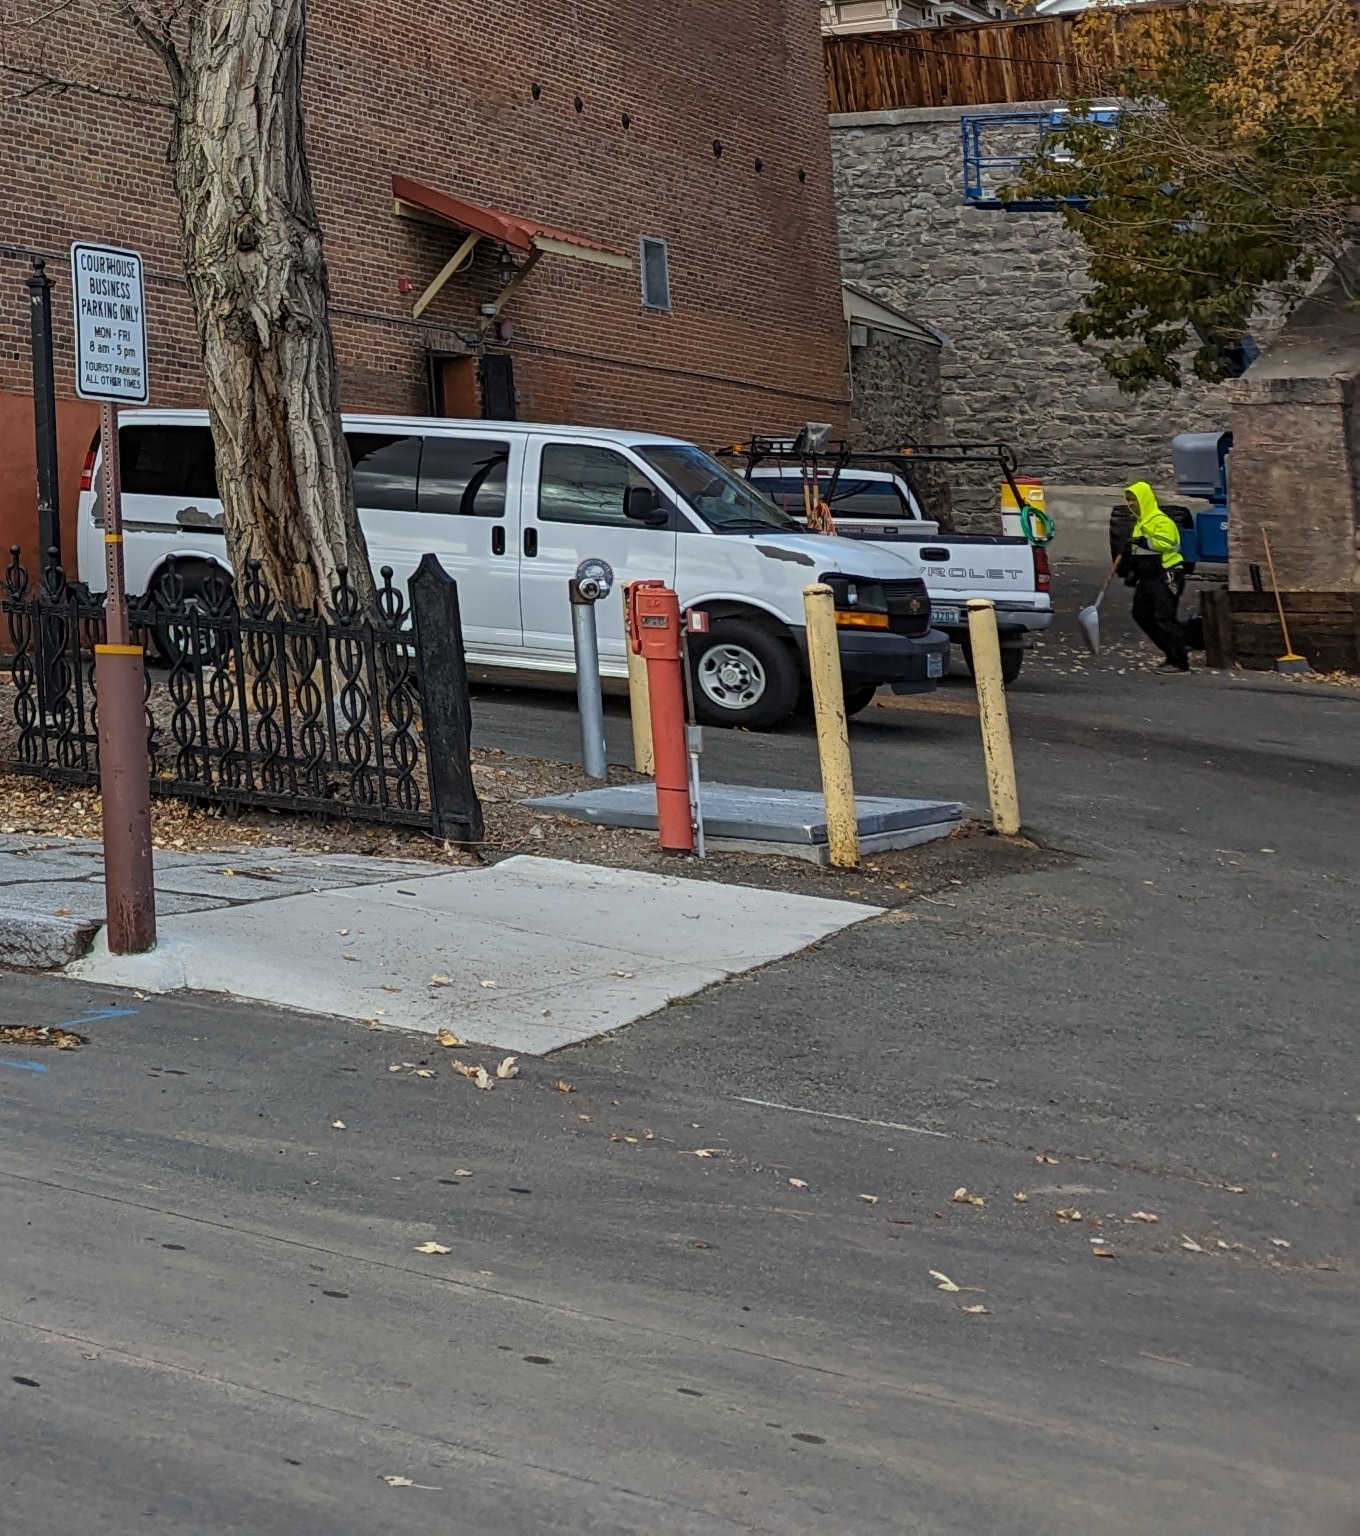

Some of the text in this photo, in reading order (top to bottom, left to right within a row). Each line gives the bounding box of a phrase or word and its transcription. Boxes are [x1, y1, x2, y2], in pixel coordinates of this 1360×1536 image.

[80, 253, 136, 279] COURTHOUSE
[89, 277, 131, 300] BUSINESS
[81, 299, 140, 323] PARKING ONLY
[94, 326, 112, 339] MON
[117, 329, 131, 342] FRI
[89, 341, 95, 353] 8
[97, 344, 110, 354] am
[116, 344, 122, 356] 5
[123, 347, 136, 360] pm
[84, 360, 141, 377] TOURIST PARKING
[85, 373, 141, 390] ALL OTHER TIMES
